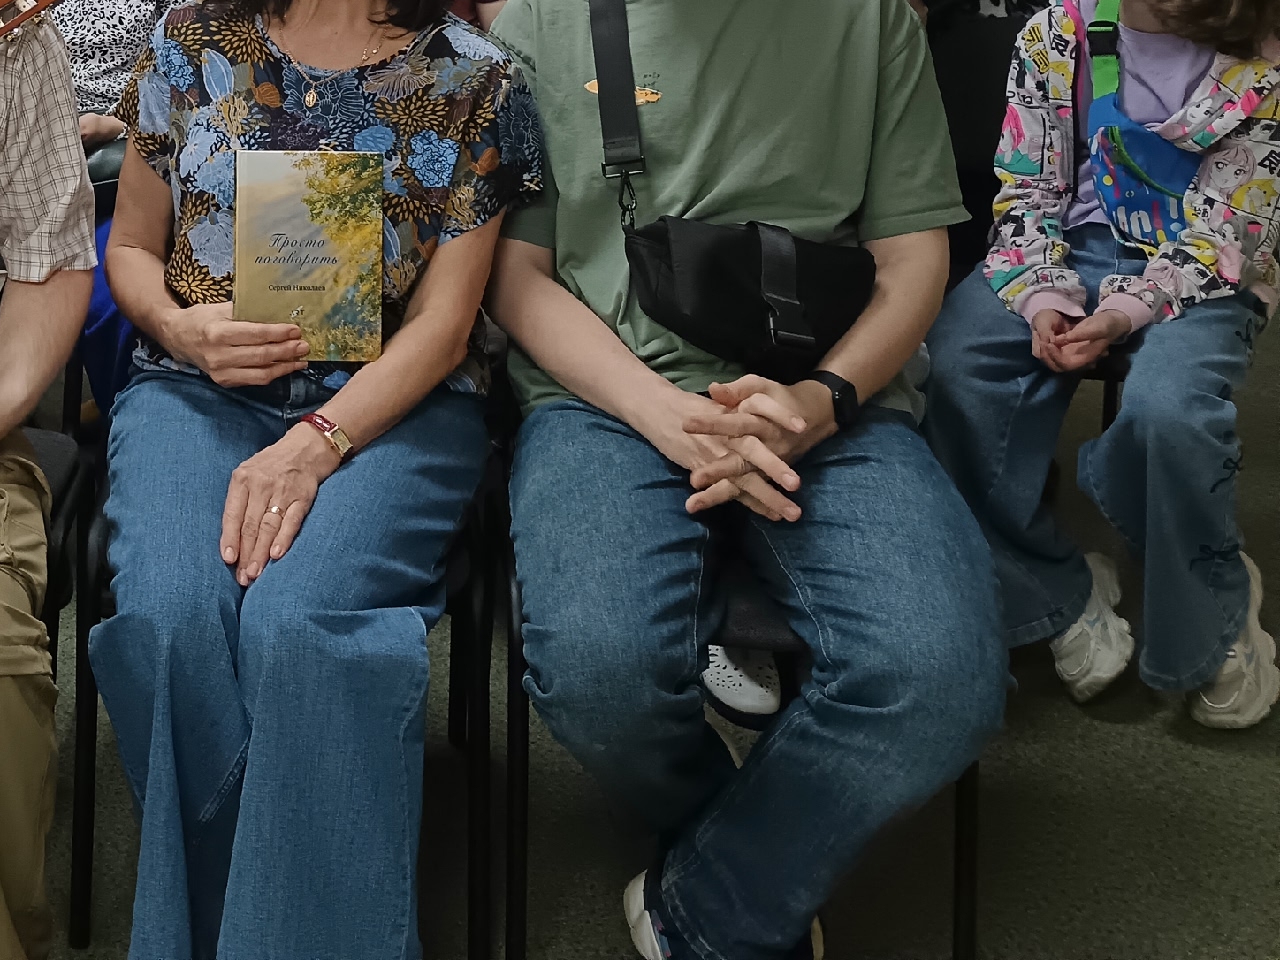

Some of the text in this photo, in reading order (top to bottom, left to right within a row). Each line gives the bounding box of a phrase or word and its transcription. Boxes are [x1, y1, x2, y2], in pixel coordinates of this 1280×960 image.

[268, 233, 325, 253] Просто
[254, 250, 338, 270] поговорить
[268, 284, 326, 293] Сергей Николаев
